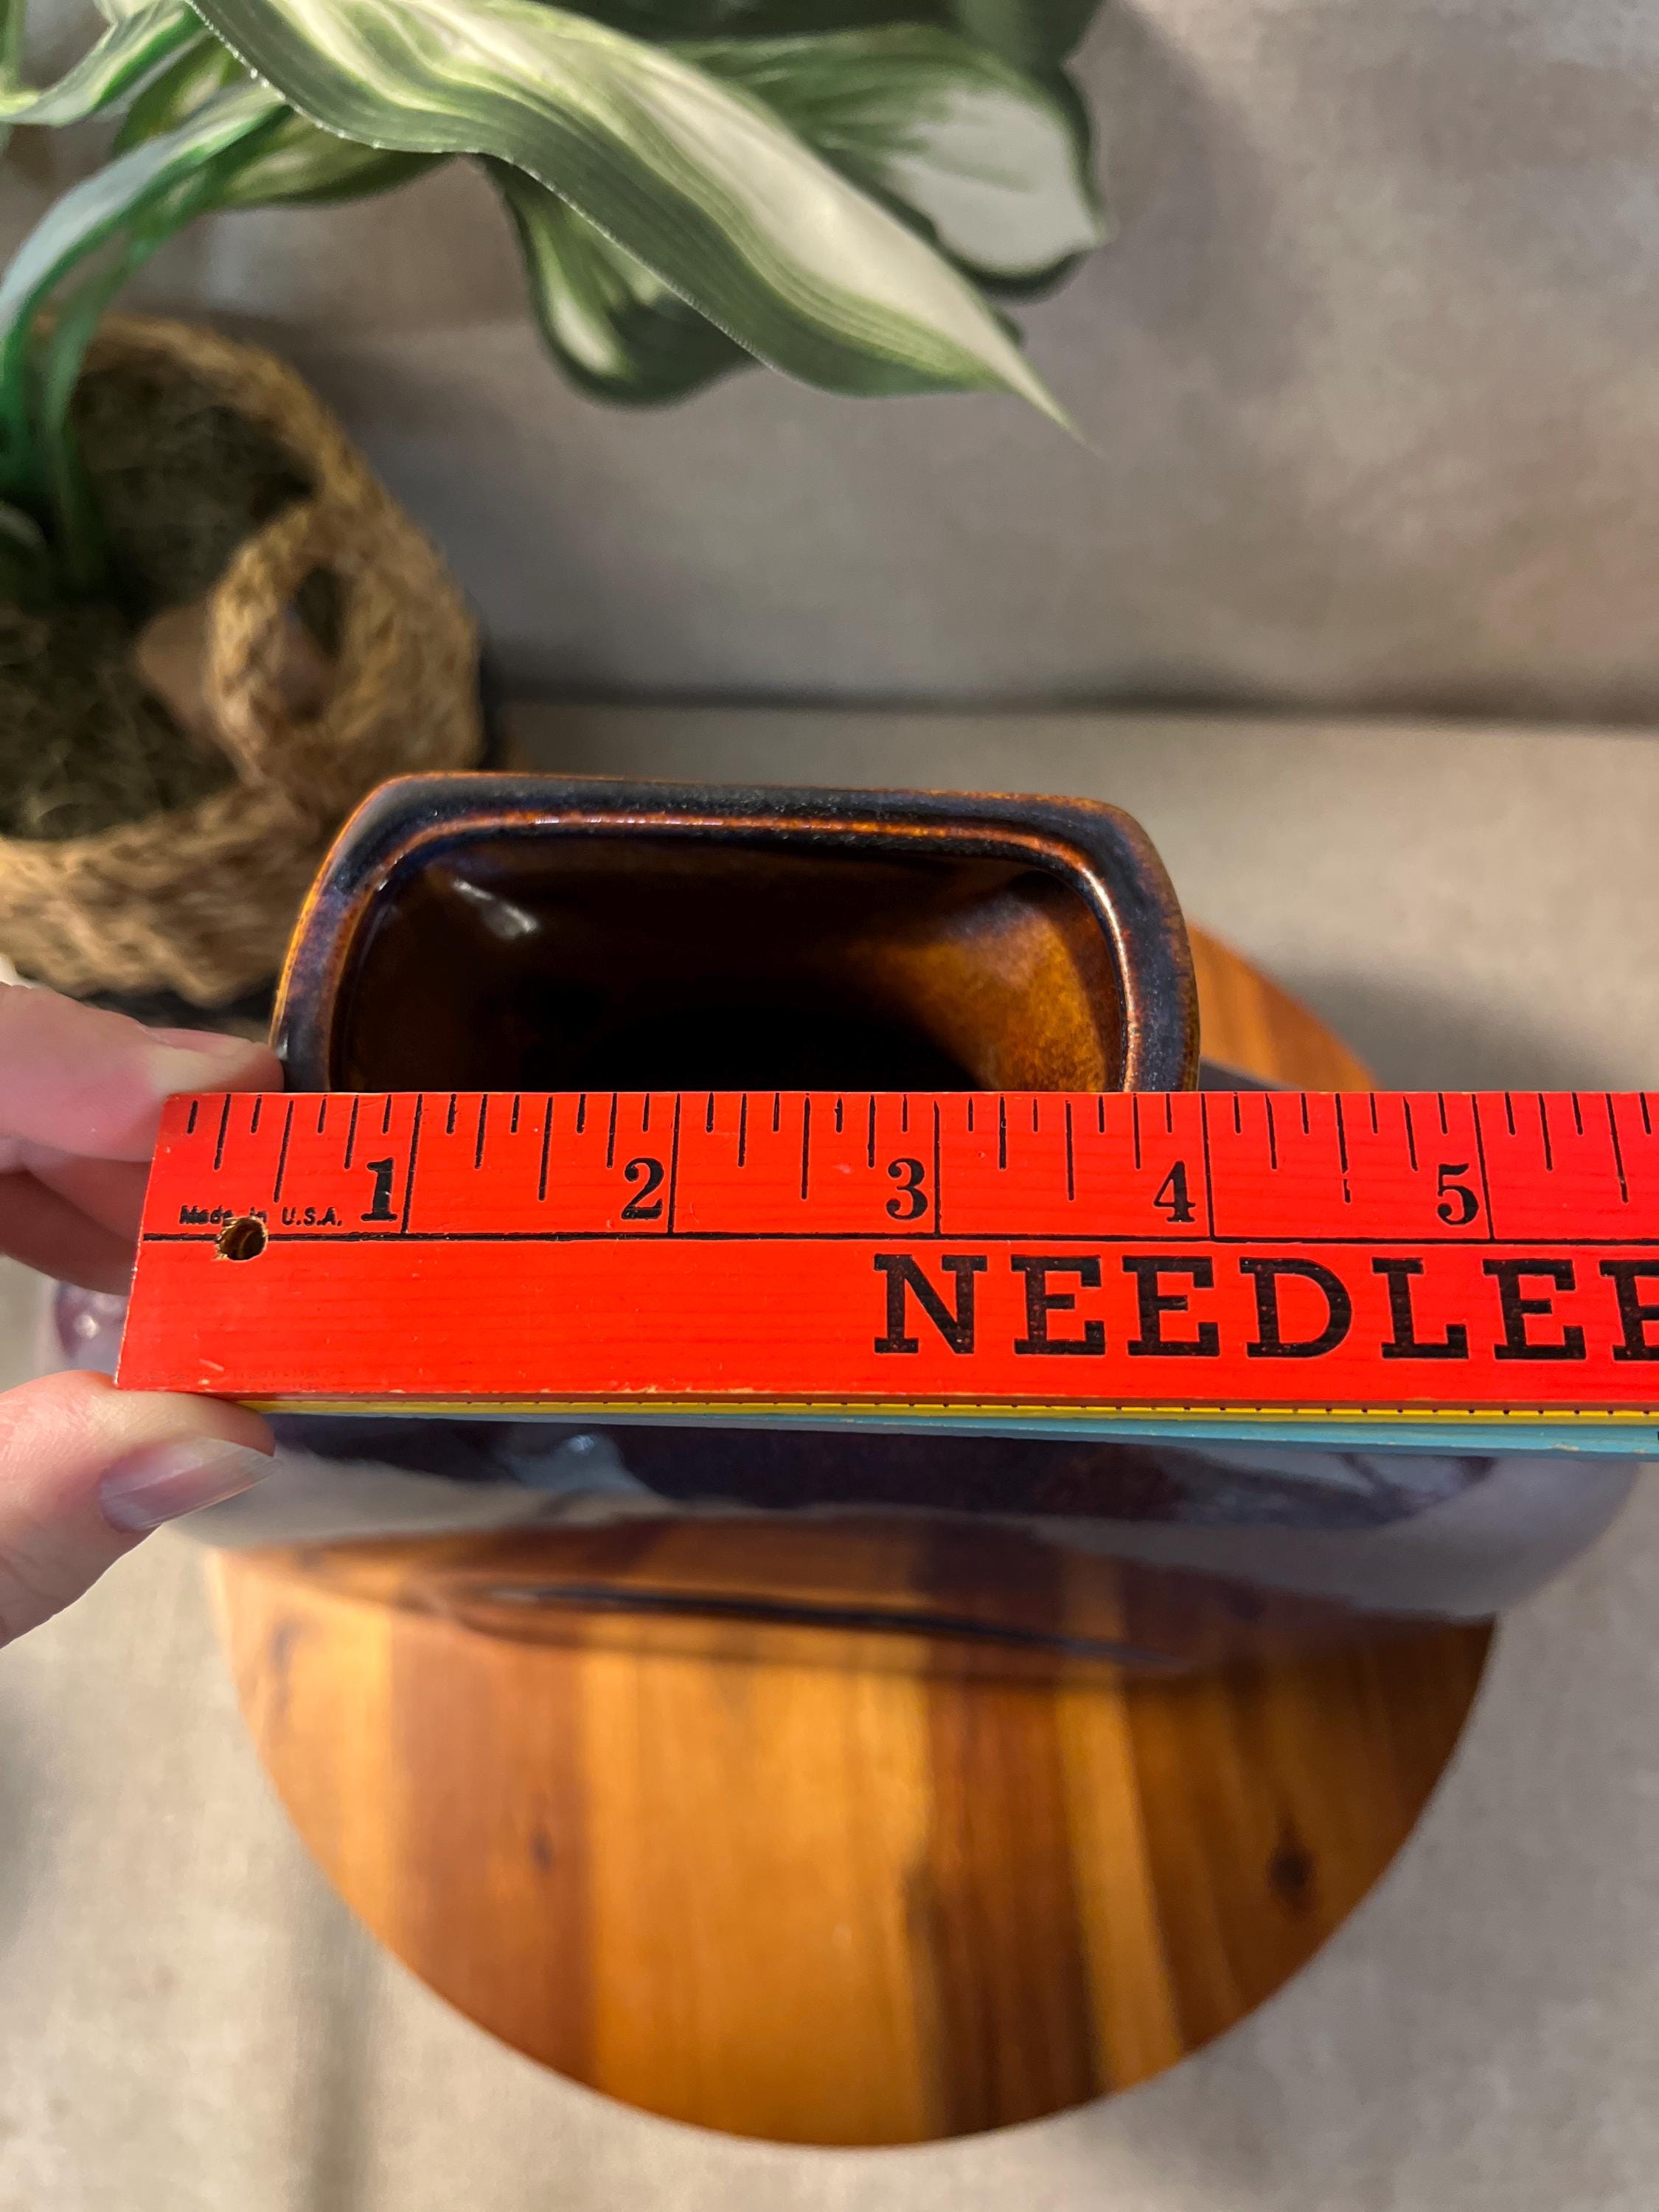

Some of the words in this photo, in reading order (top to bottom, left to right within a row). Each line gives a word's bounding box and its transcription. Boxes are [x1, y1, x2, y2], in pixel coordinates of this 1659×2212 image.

[361, 1158, 397, 1222] 1
[621, 1158, 664, 1220] 2
[886, 1158, 928, 1220] 3
[1153, 1161, 1196, 1222] 4
[1437, 1163, 1479, 1225] 5
[282, 1207, 342, 1226] U.S.A.
